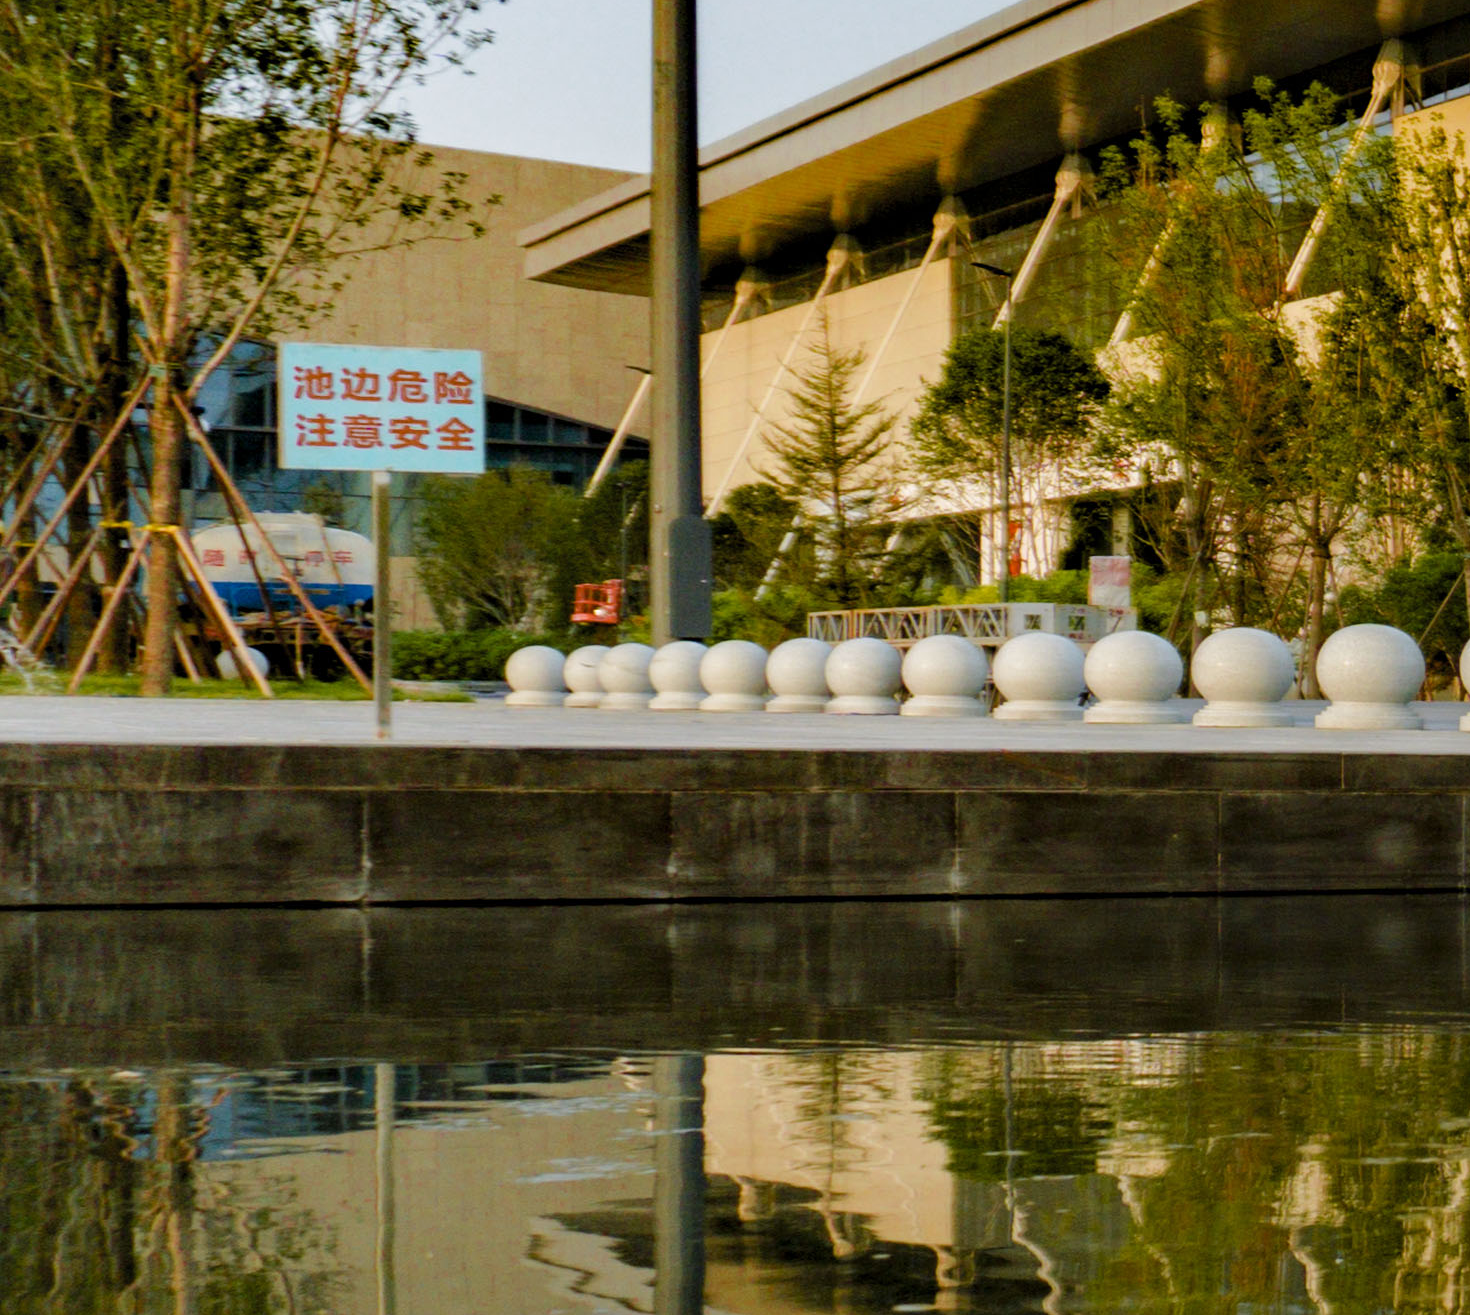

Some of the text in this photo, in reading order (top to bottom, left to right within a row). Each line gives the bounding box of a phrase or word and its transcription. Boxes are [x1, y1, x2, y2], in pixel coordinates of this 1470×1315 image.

[293, 365, 475, 405] 池边危险
[295, 413, 476, 452] 注意安全
